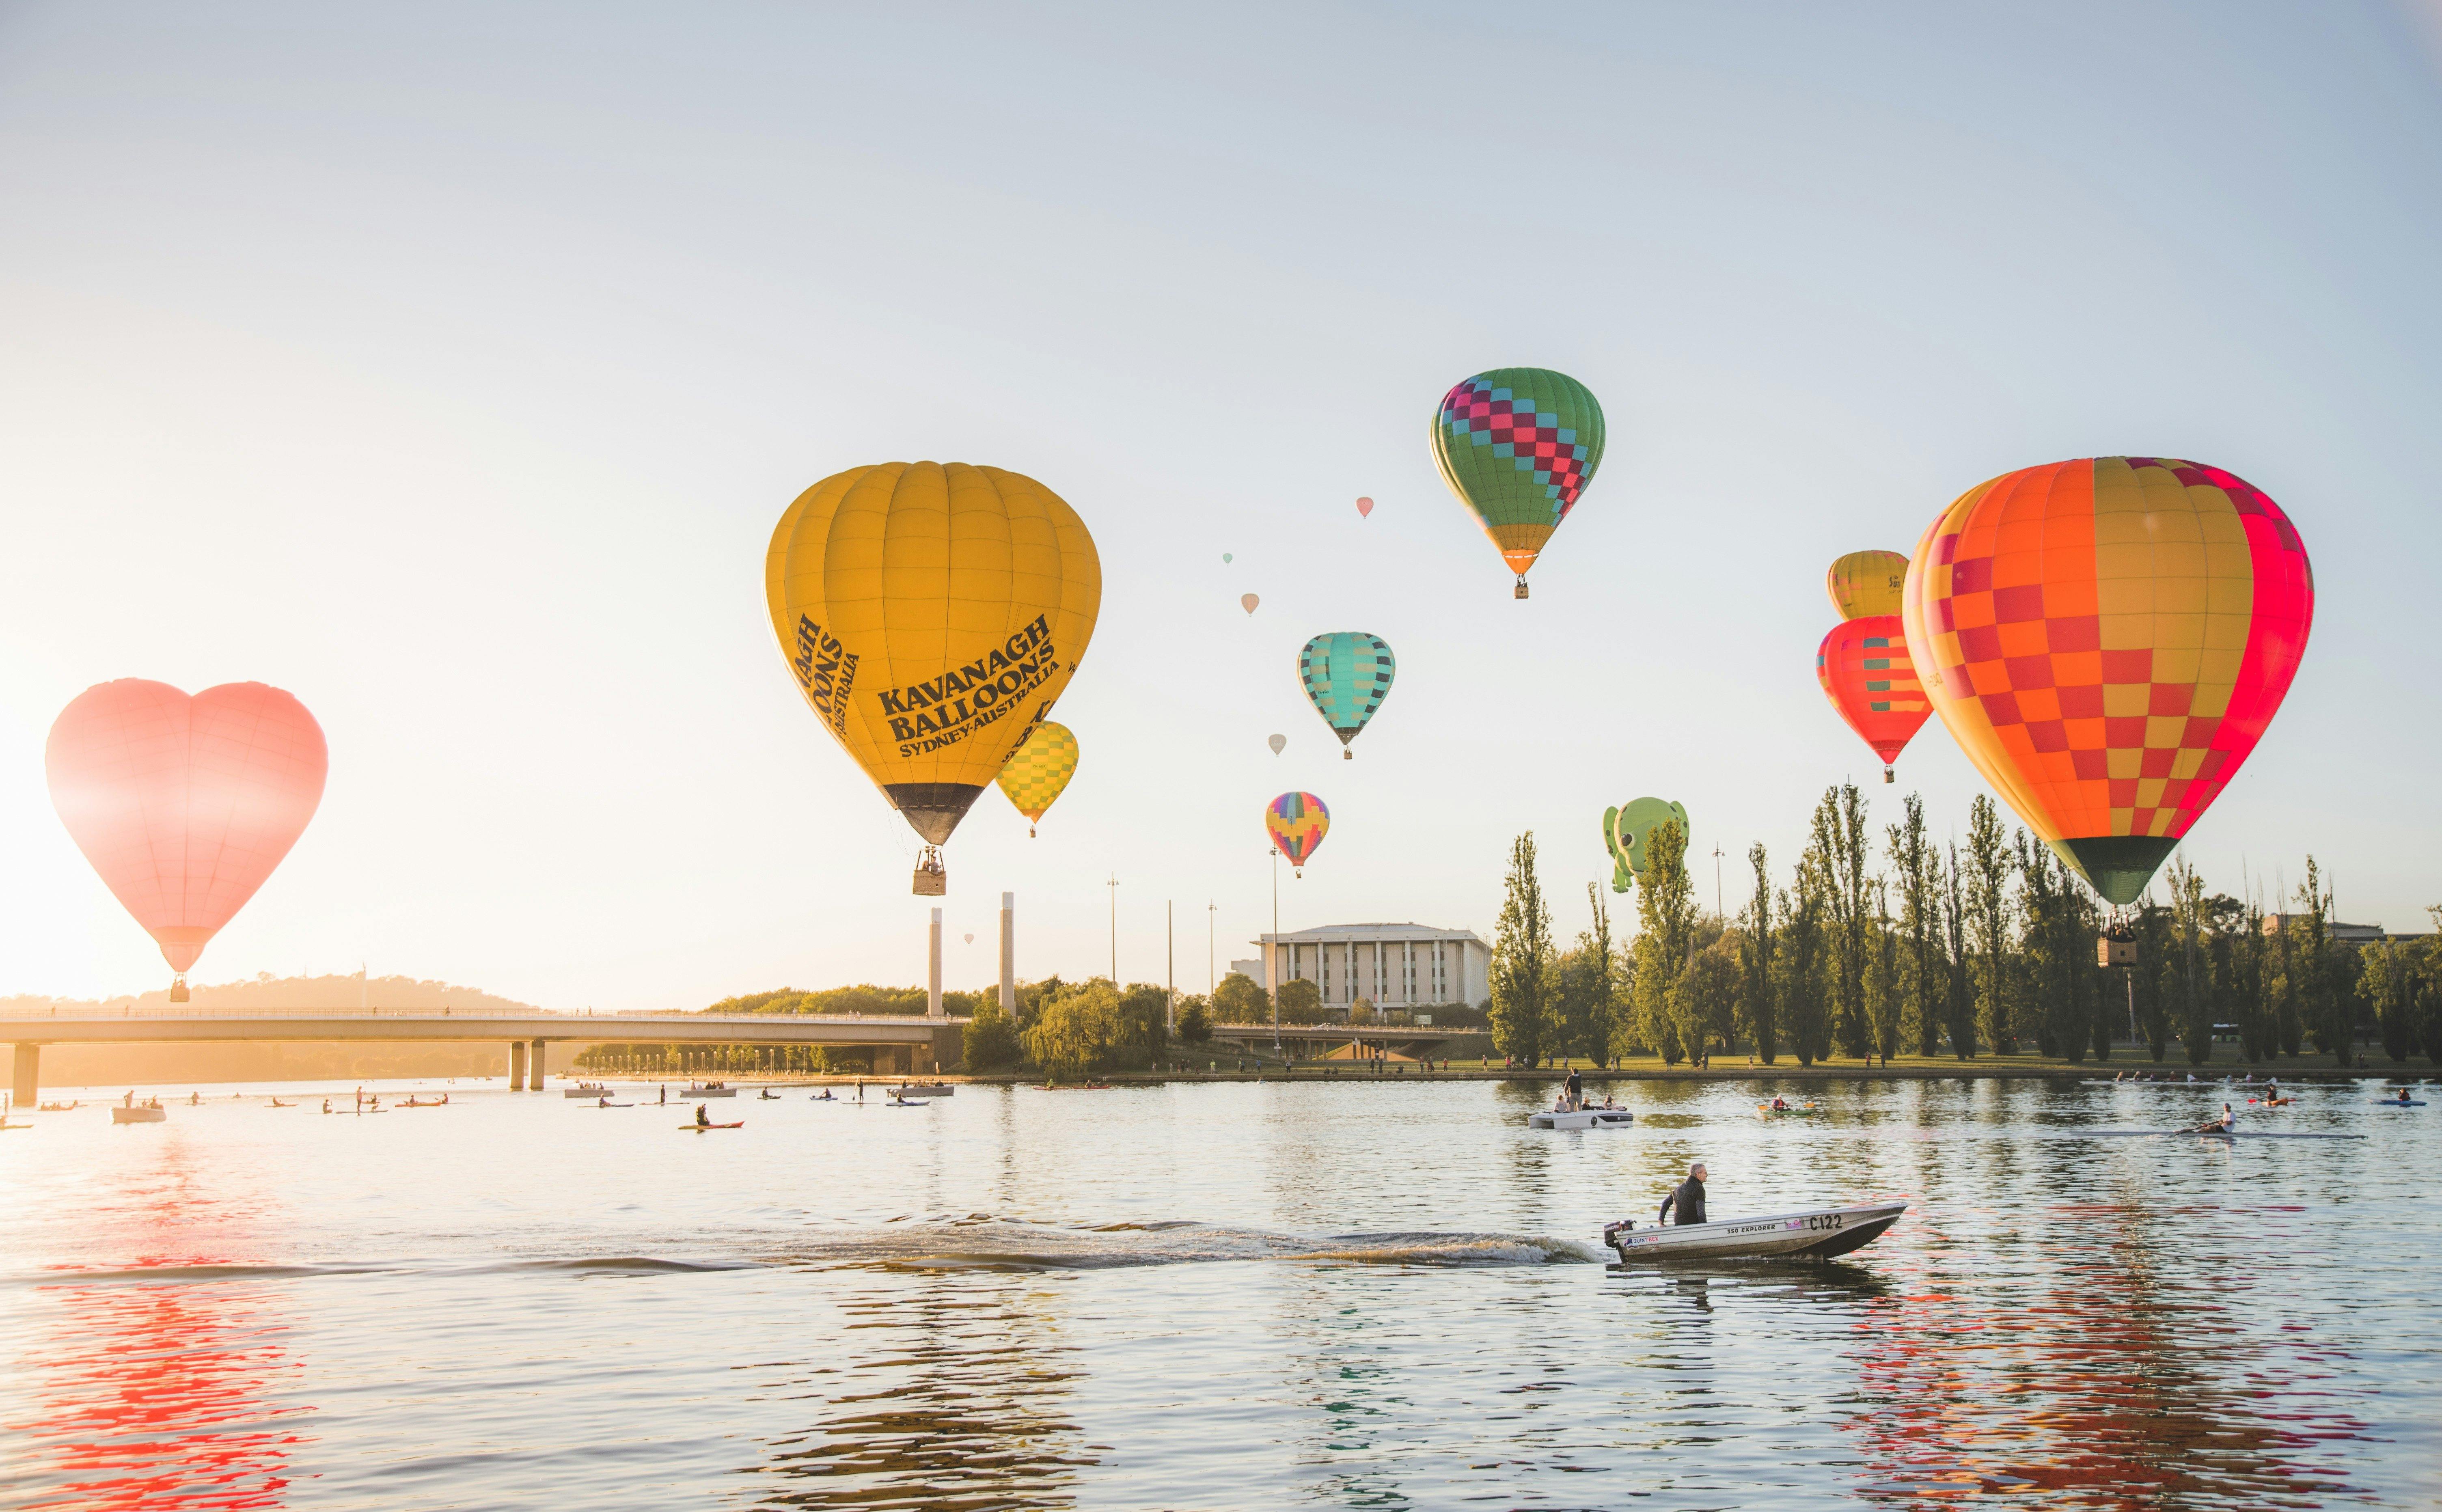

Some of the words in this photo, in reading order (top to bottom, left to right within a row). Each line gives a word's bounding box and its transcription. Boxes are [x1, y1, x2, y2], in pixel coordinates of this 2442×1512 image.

[877, 613, 1050, 716] KAVANAGH
[888, 636, 1055, 742] BALLOONS
[1741, 1224, 1775, 1232] EXPLORER
[1810, 1214, 1843, 1230] C122
